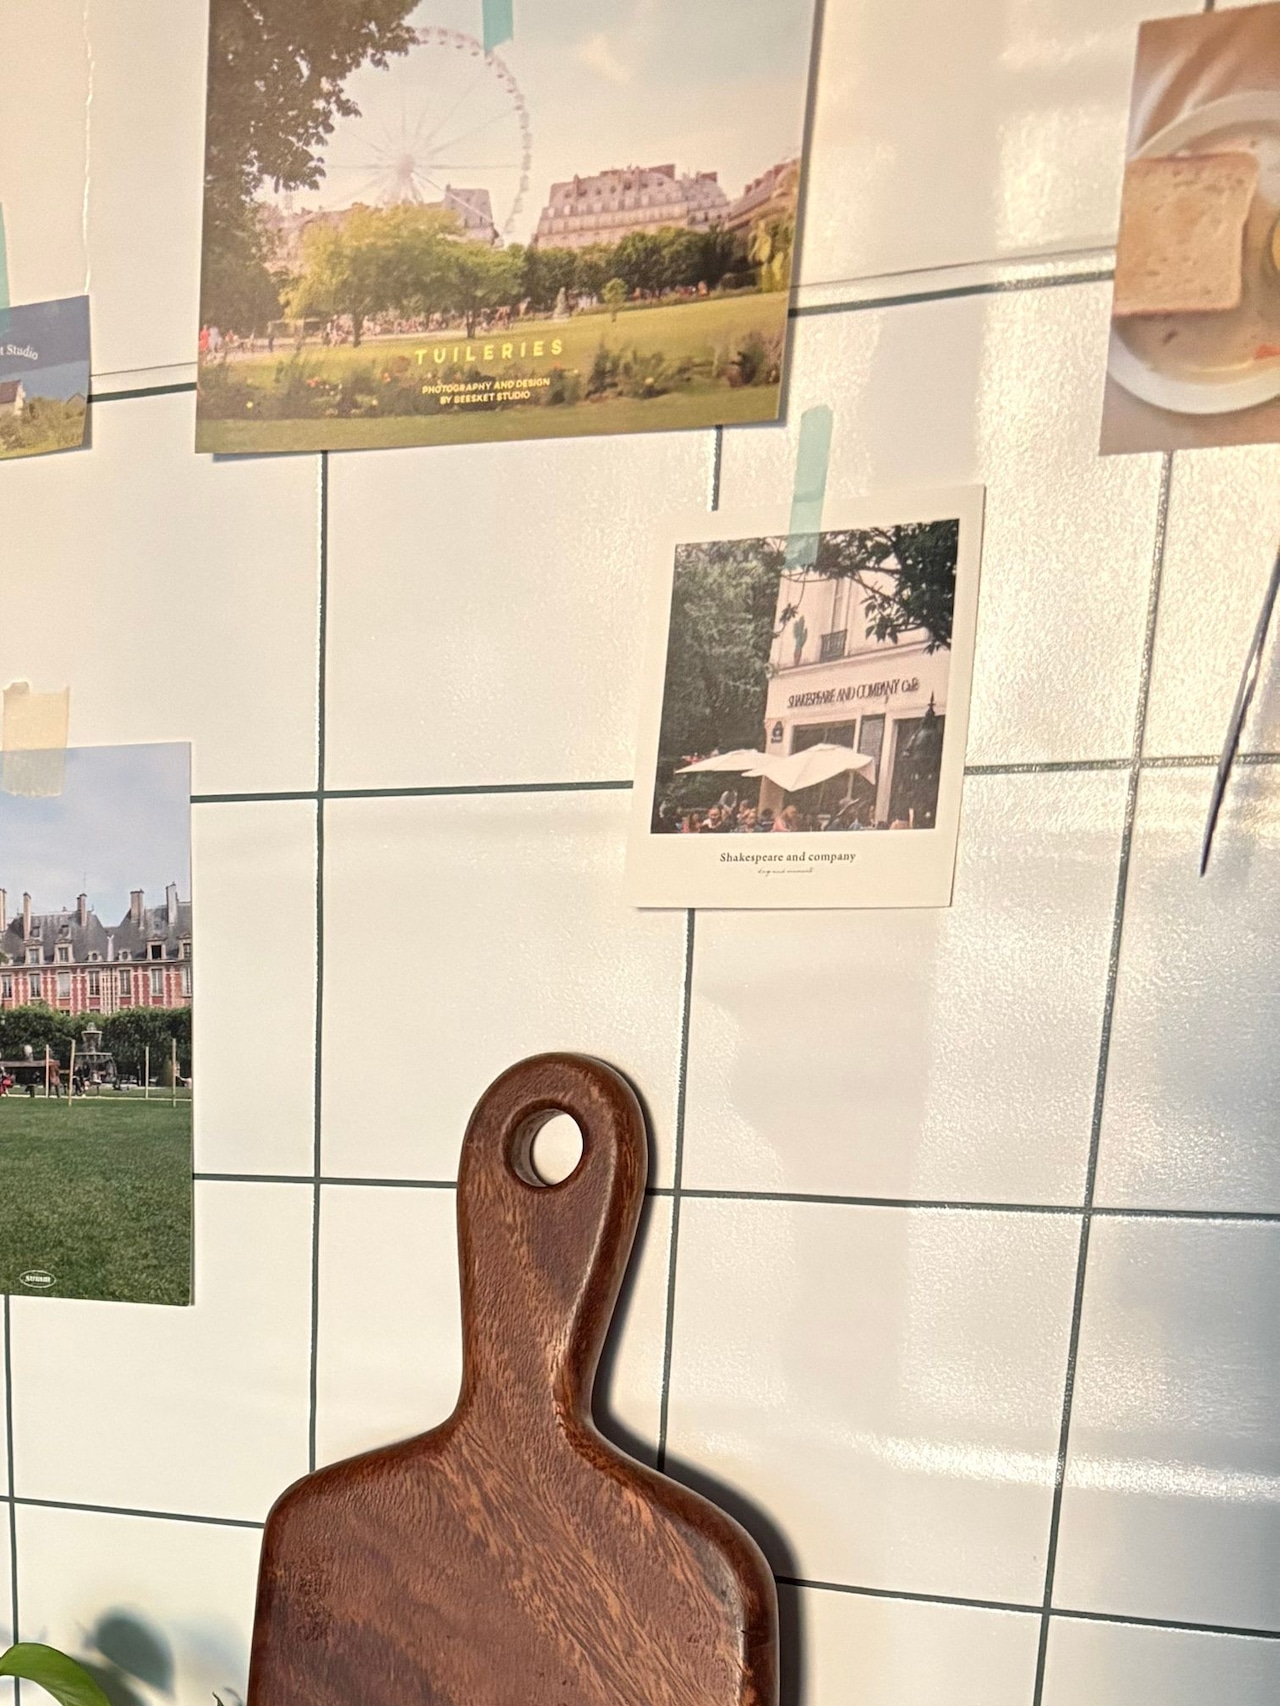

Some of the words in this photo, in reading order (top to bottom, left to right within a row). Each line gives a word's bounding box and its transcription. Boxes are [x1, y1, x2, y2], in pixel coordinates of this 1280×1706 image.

[6, 343, 39, 361] Studio
[415, 339, 562, 364] TUILERIES
[422, 381, 493, 394] PHOTOGRAPHY
[494, 379, 515, 390] AND
[516, 378, 550, 388] DESIGN
[497, 390, 531, 402] STUDIO
[720, 853, 784, 864] Shakespeare
[786, 852, 806, 862] and
[808, 853, 856, 864] company
